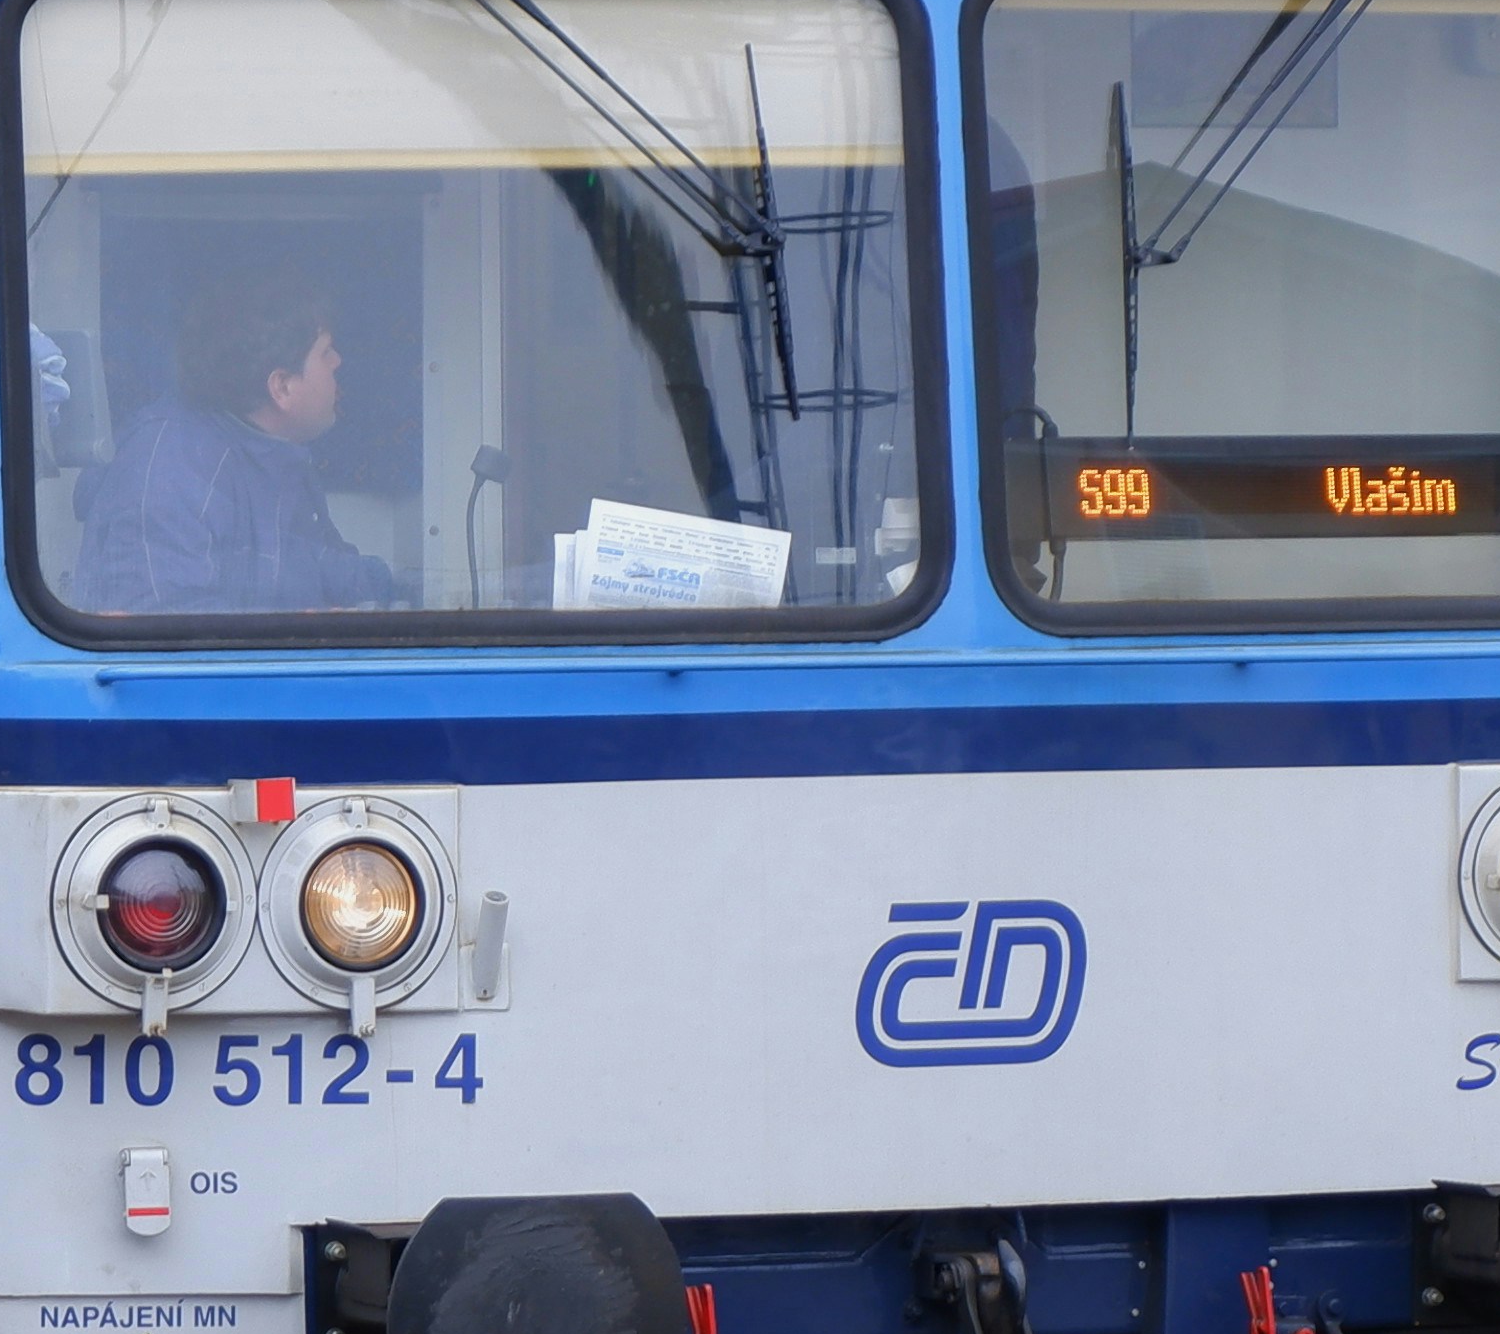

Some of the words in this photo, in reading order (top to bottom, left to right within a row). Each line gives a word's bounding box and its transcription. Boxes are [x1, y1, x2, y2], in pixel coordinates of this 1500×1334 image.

[1079, 468, 1150, 515] S99
[1324, 466, 1457, 515] Vlašim
[14, 1032, 175, 1107] 810
[190, 1170, 238, 1196] OIS
[40, 1298, 184, 1328] NAPÁJENÍ
[193, 1305, 237, 1327] MN
